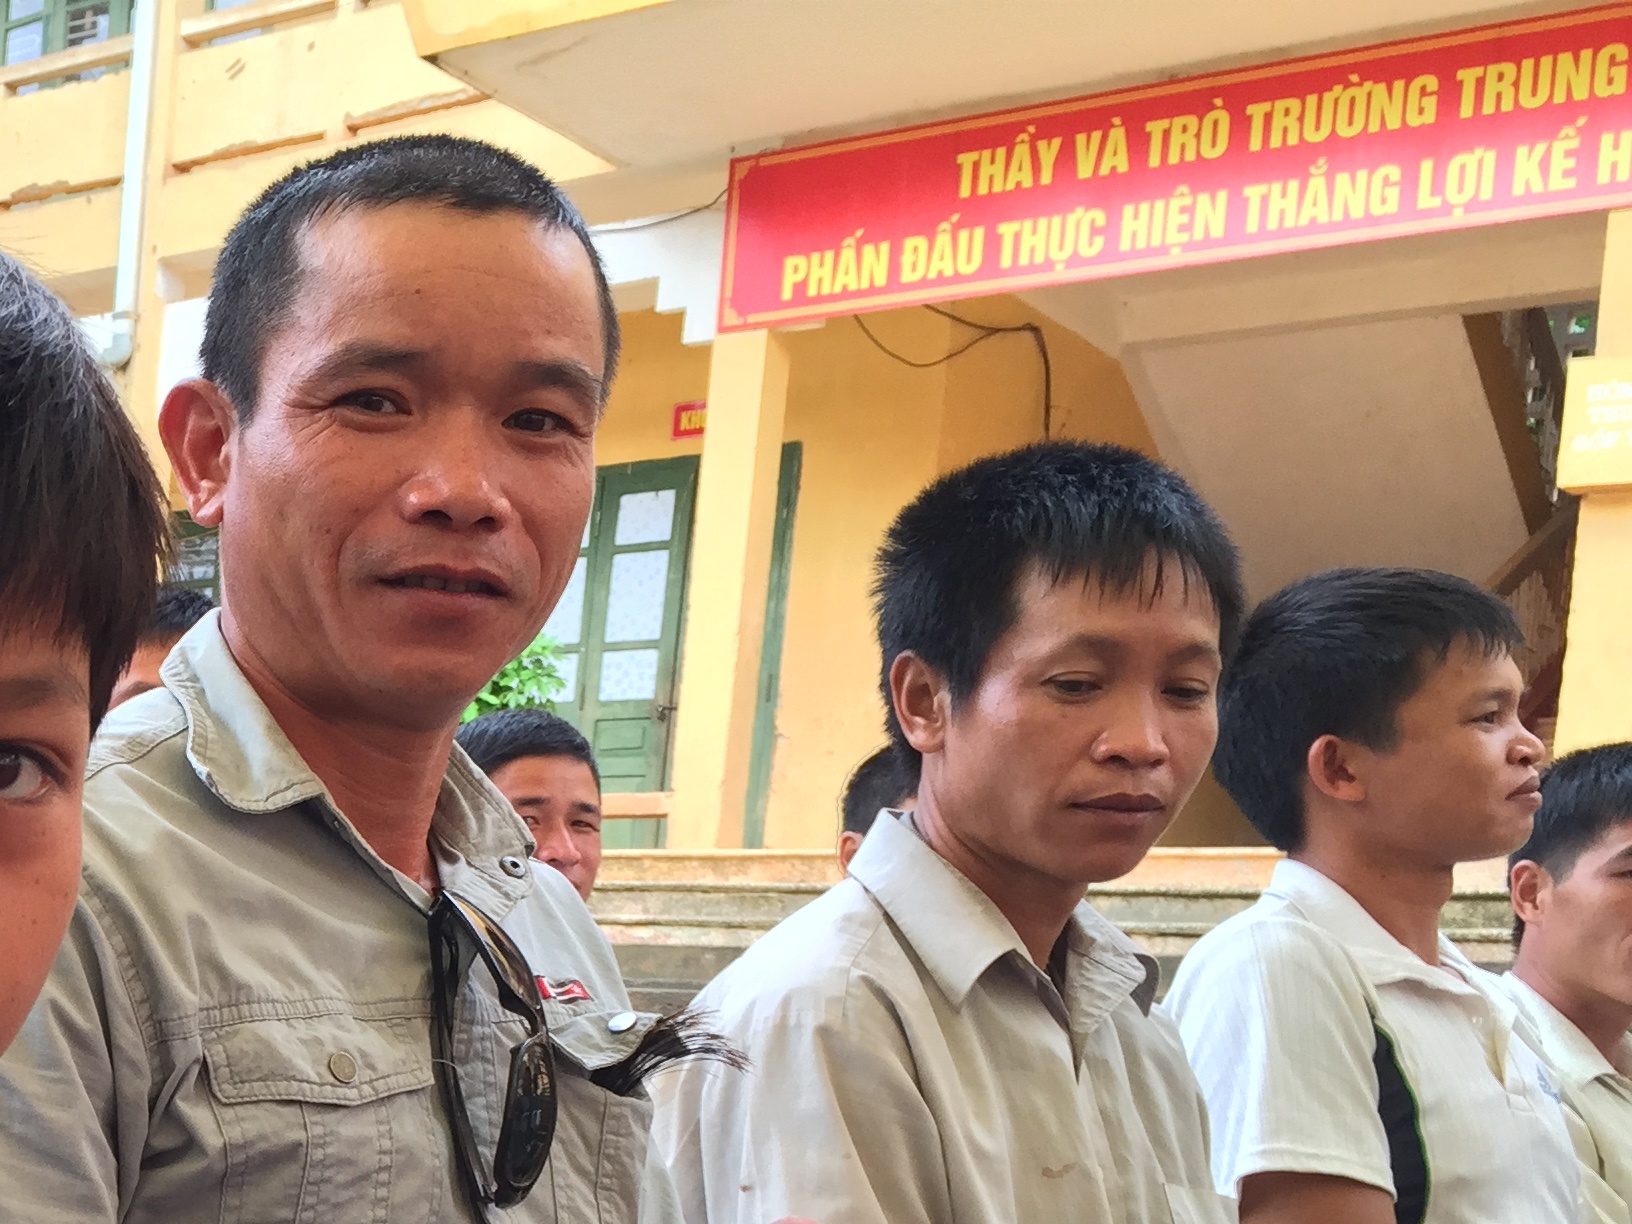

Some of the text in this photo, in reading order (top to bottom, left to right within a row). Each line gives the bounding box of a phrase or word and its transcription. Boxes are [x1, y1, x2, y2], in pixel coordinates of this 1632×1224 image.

[956, 42, 1629, 198] THẦY VÀ TRÒ TRƯỜNG TRUNG
[781, 228, 891, 301] PHẤN
[900, 213, 985, 283] ĐẤU
[997, 206, 1107, 272] THỰC
[1119, 184, 1228, 255] HIỆN
[1243, 157, 1402, 233] THẮNG
[1416, 147, 1497, 217] LỢI
[1512, 115, 1589, 196] KẾ
